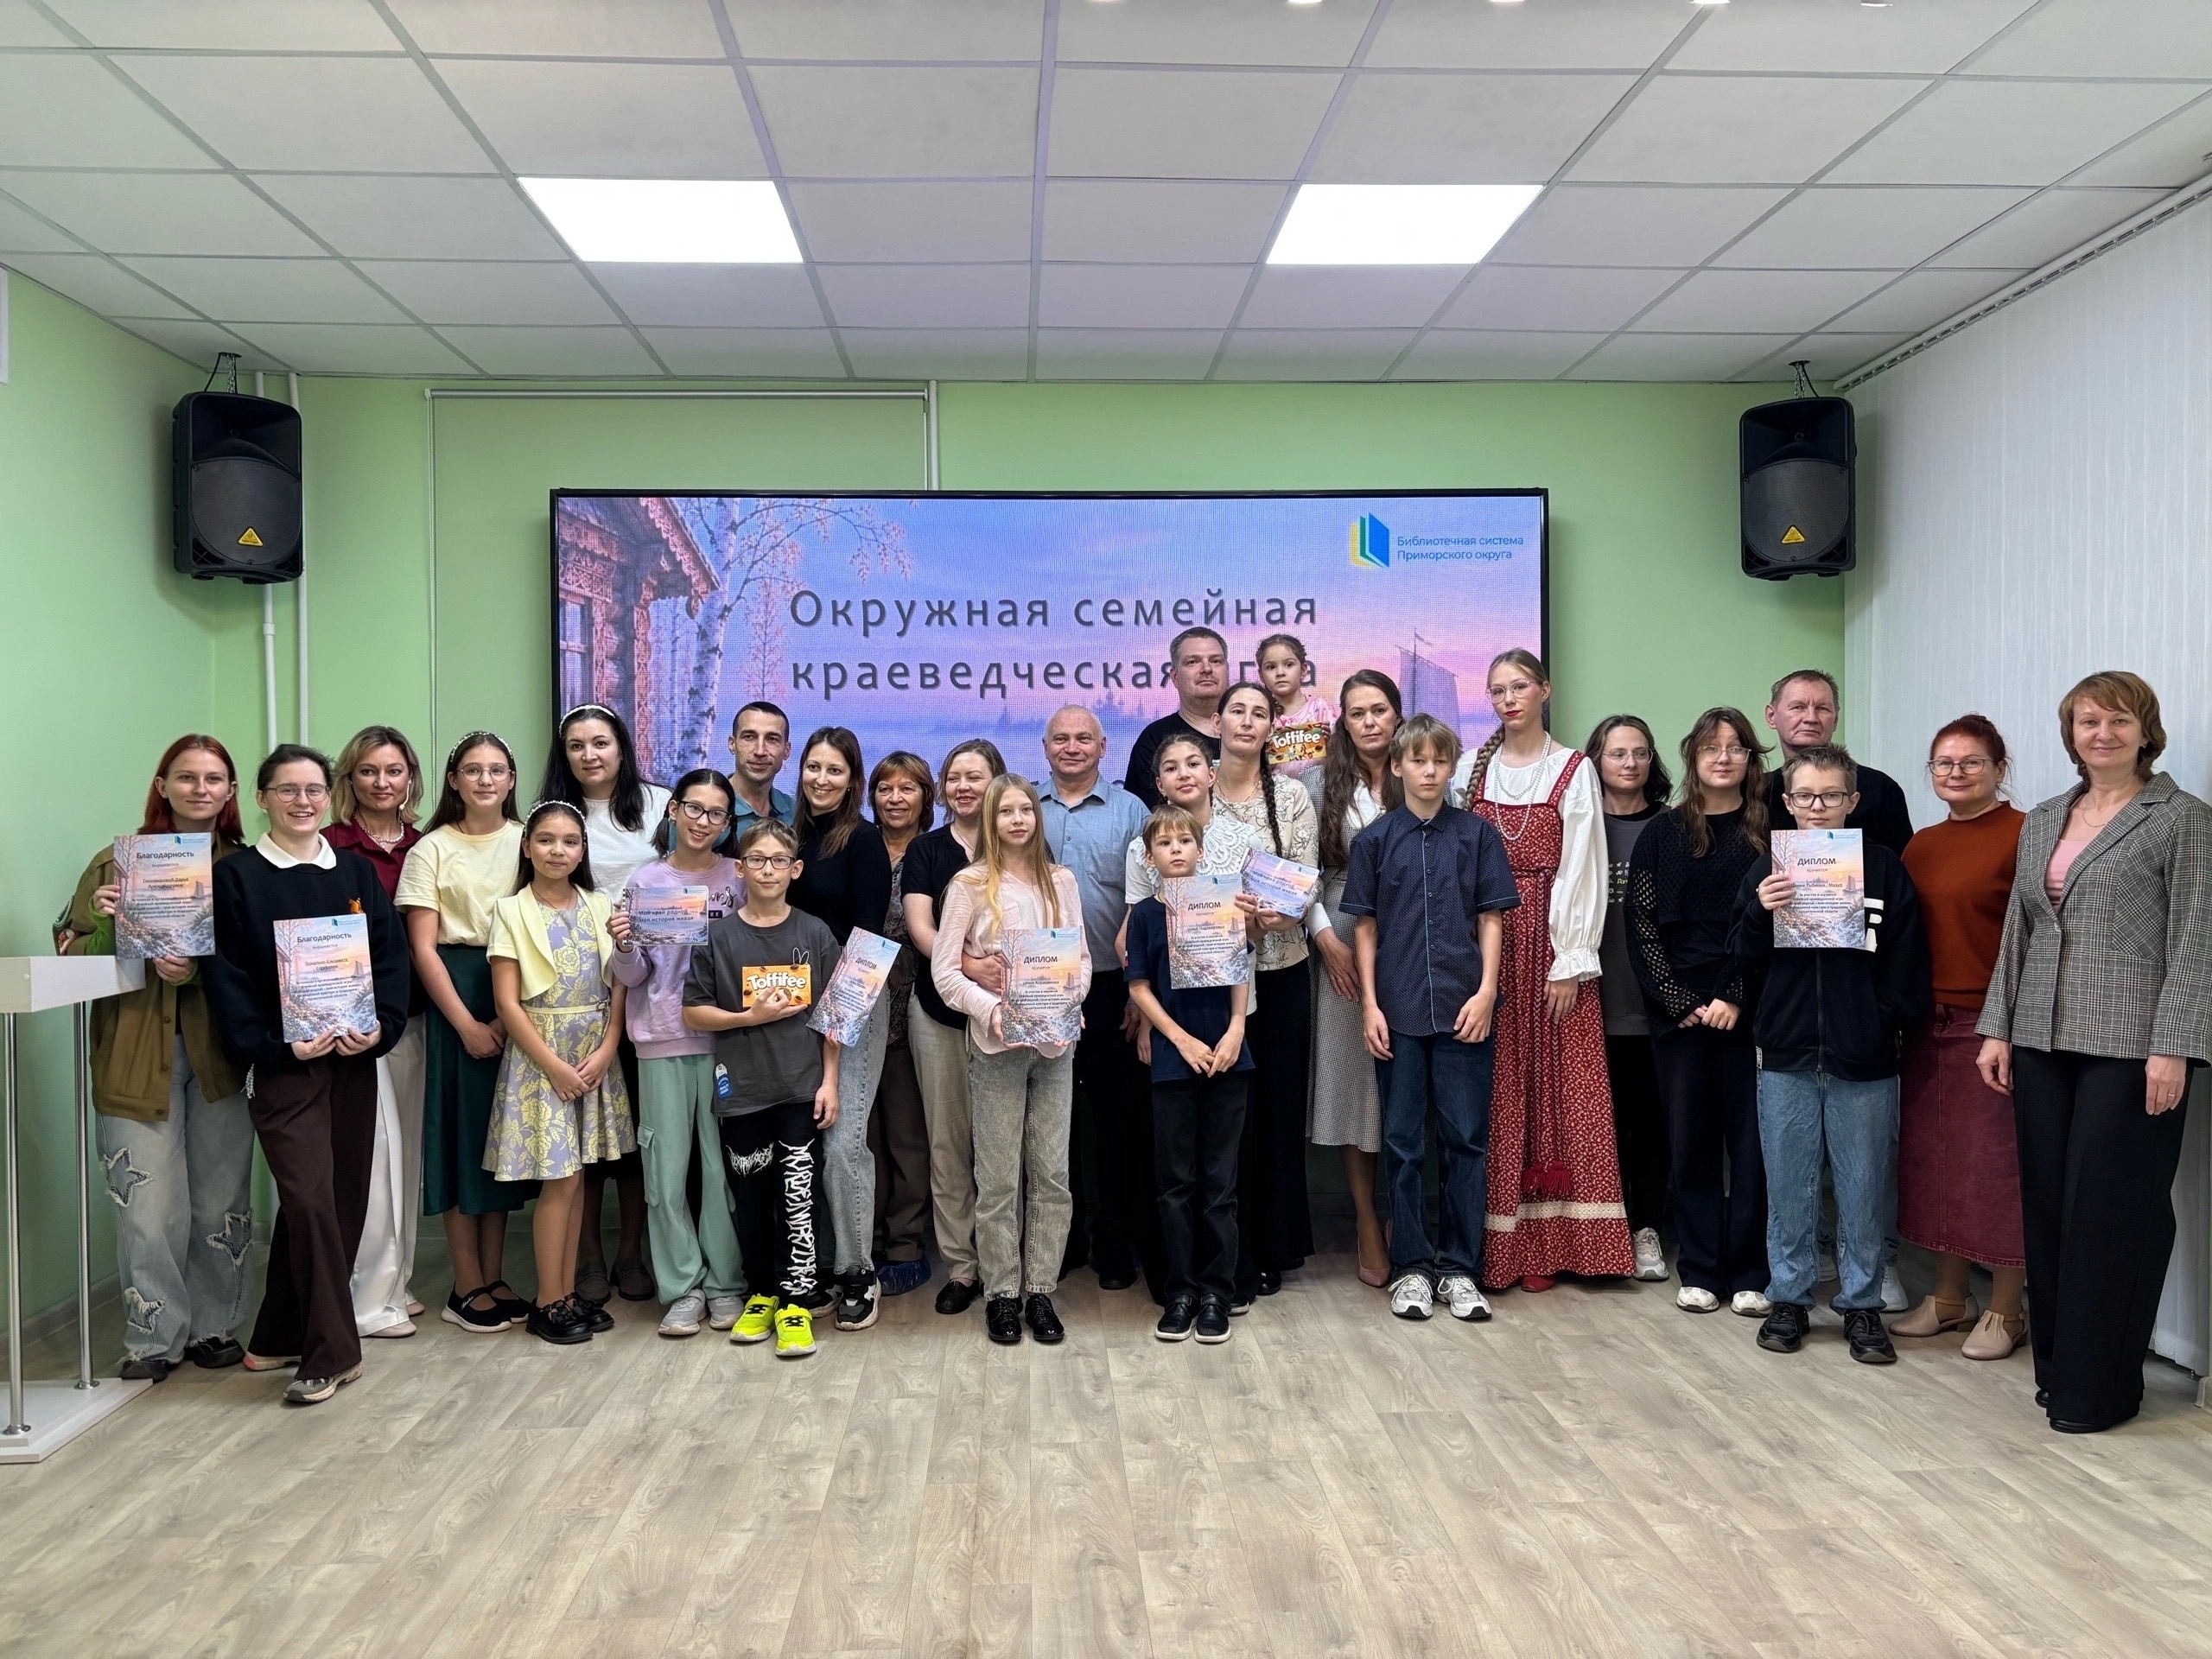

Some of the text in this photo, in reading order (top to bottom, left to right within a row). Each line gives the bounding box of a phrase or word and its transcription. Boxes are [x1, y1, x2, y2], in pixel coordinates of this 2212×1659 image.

[1397, 537, 1476, 546] Библиотечная
[1397, 550, 1512, 561] Приморского округа
[791, 588, 1317, 638] Окружная семейная
[1273, 730, 1321, 748] Toffifee
[137, 851, 194, 860] Благодарность
[1188, 901, 1221, 911] ДИПЛОМ
[297, 933, 352, 943] Благодарность
[855, 957, 878, 970] ДИПЛОМ
[747, 971, 806, 990] Toffifee
